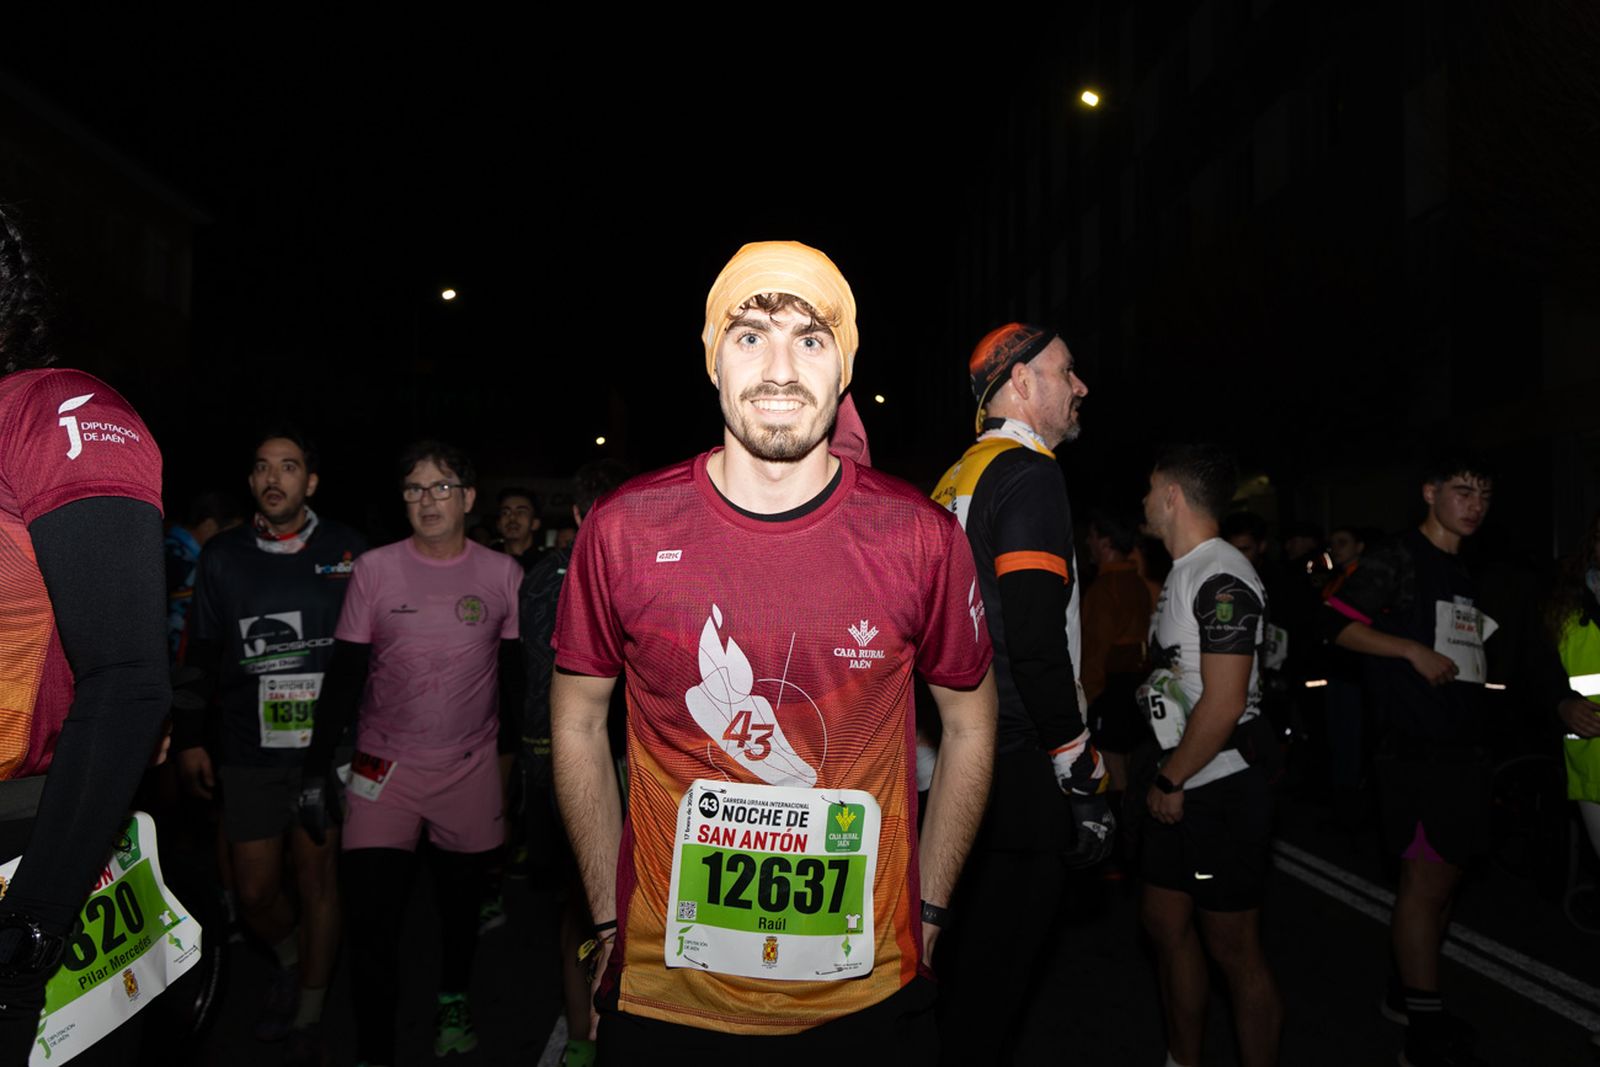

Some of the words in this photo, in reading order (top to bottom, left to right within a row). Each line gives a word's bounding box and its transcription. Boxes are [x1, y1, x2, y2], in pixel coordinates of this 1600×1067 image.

[81, 421, 140, 443] DIPUTACIÓN
[84, 432, 99, 441] DE
[101, 433, 125, 444] JAÉN
[834, 647, 857, 659] CAJA
[859, 648, 885, 660] RURAL
[722, 710, 775, 762] 43
[700, 797, 719, 812] 43
[723, 796, 746, 805] CARRERA
[747, 799, 769, 807] URBANA
[769, 801, 810, 810] INTERNACIONAL
[721, 804, 783, 827] NOCHE
[786, 810, 810, 828] DE
[697, 824, 737, 848] SAN
[739, 828, 809, 853] ANTÓN
[702, 851, 850, 915] 12637
[758, 917, 787, 931] Raúl
[78, 965, 110, 991] Pilar
[110, 934, 152, 970] Mercedes
